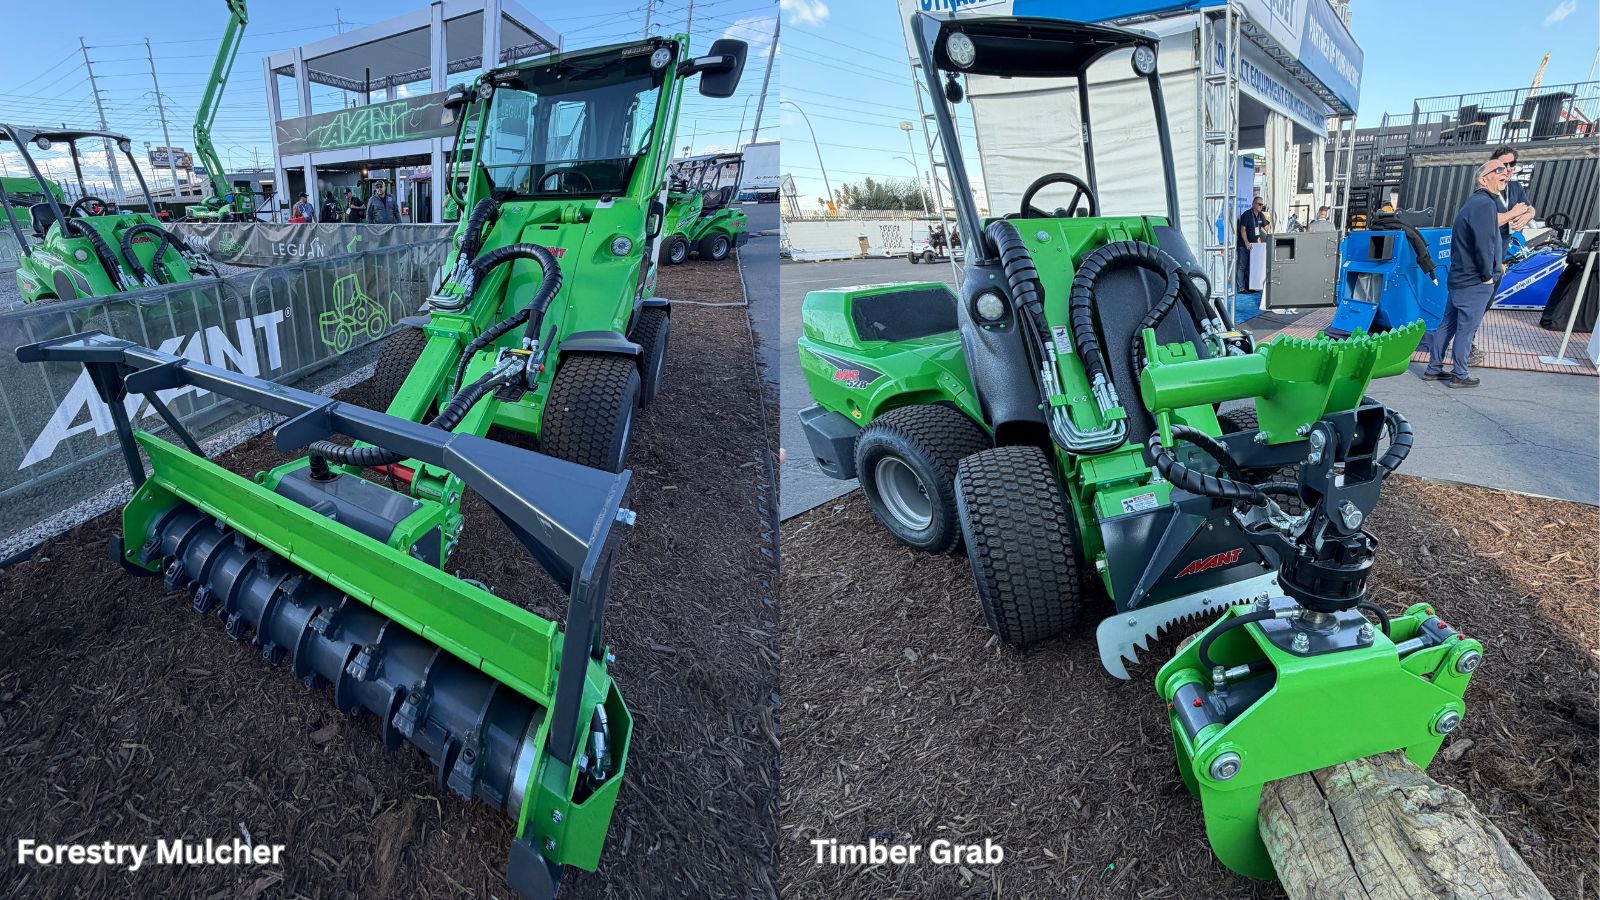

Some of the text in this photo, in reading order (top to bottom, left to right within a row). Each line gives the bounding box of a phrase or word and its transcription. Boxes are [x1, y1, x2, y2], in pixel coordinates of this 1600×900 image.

[1250, 65, 1285, 105] EQUIPMENT
[320, 102, 408, 148] AVANT
[847, 380, 868, 389] 528
[1174, 548, 1244, 579] AVANT
